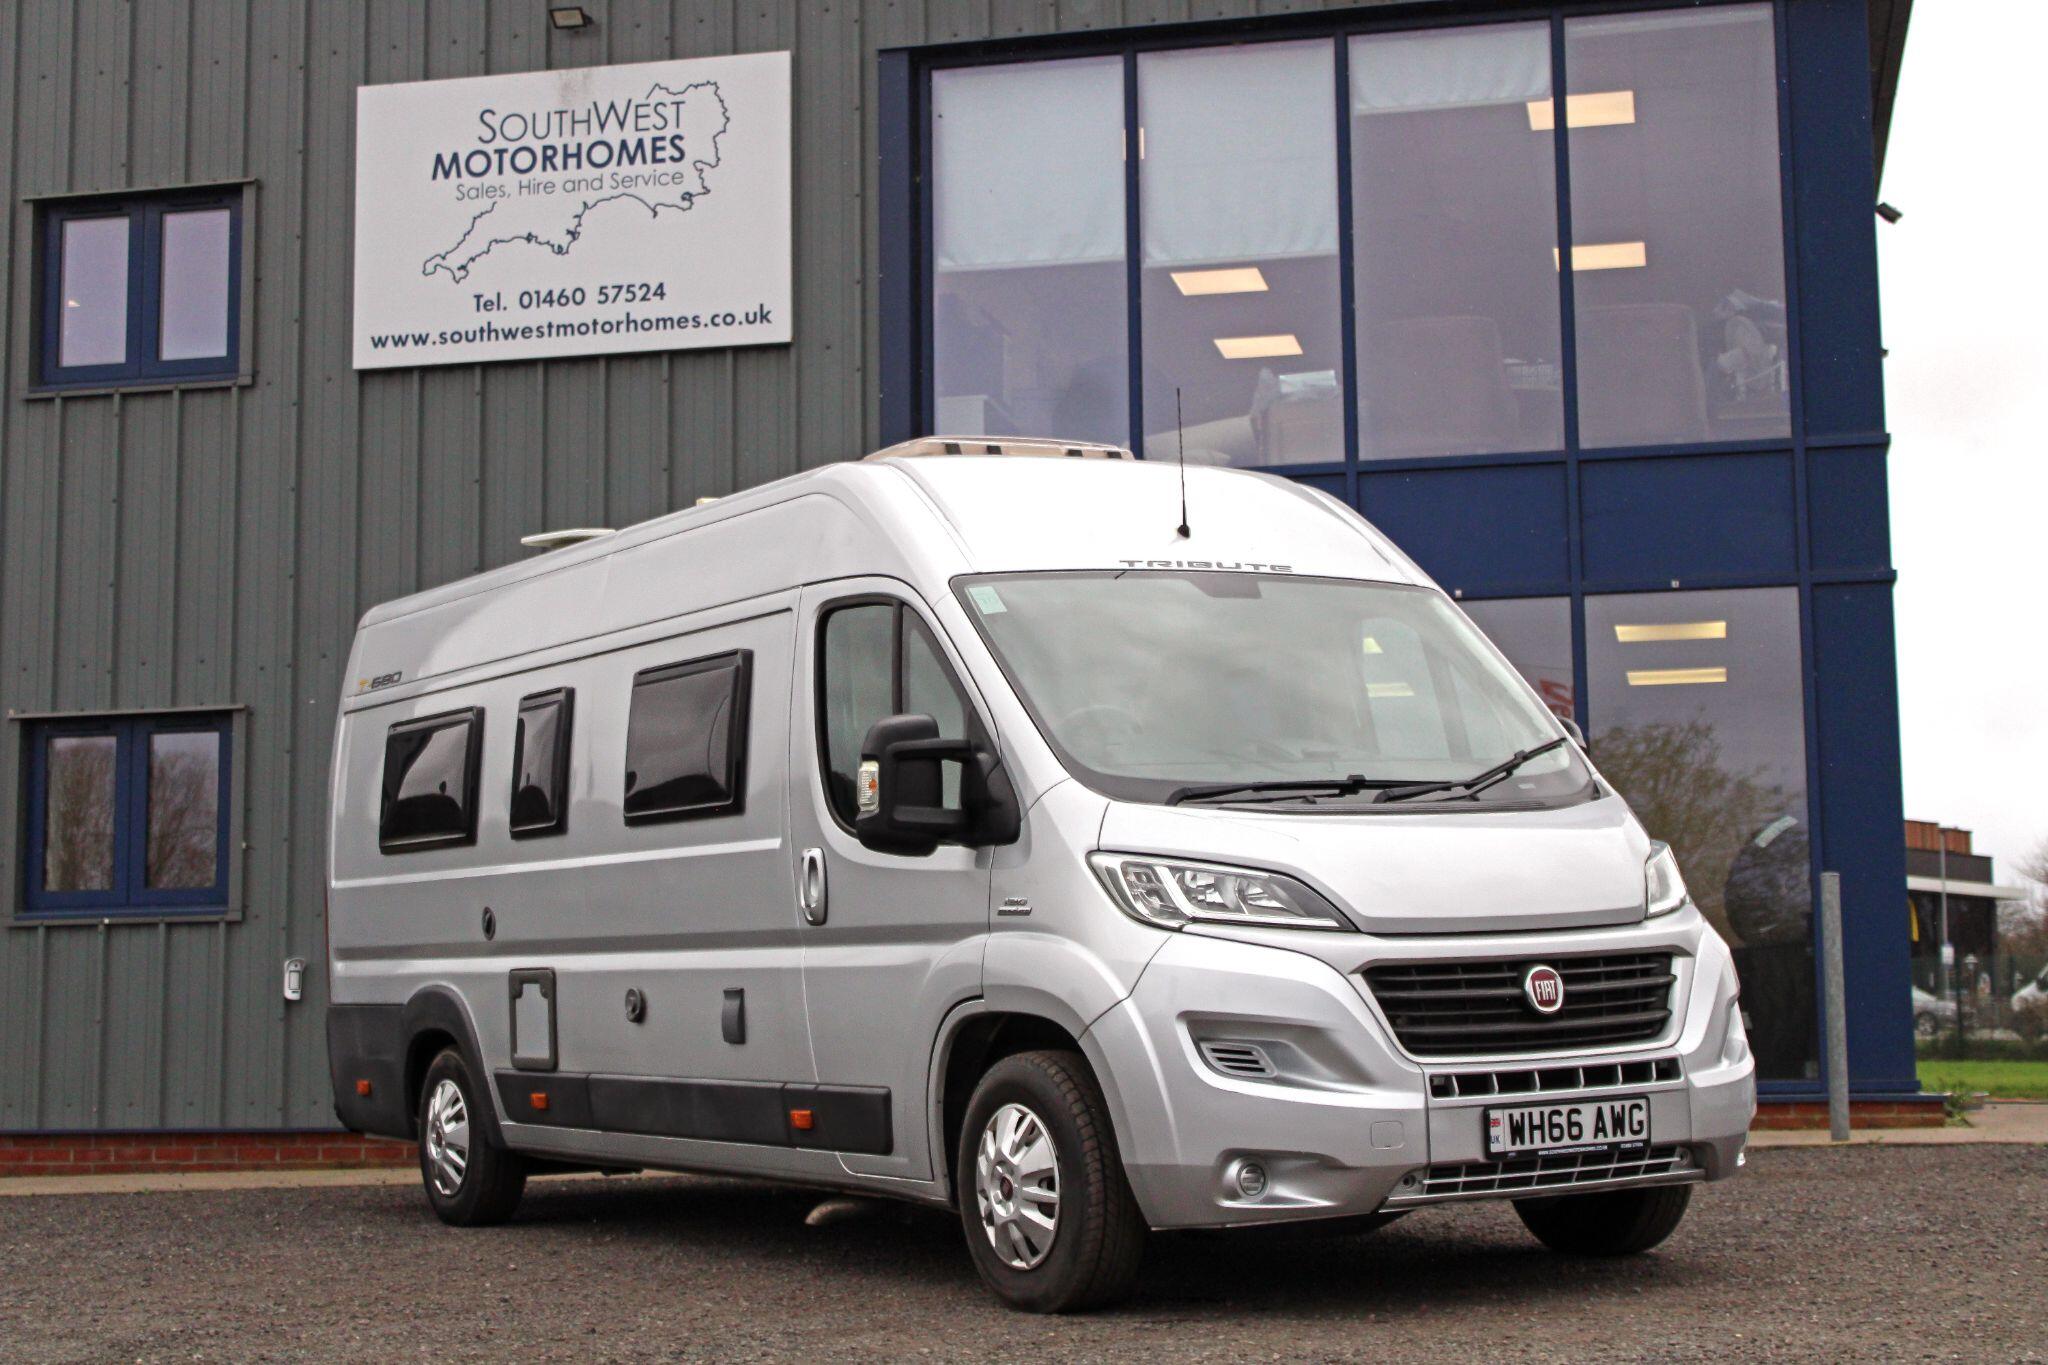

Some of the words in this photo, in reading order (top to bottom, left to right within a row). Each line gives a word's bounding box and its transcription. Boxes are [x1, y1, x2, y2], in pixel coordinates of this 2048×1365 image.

[431, 134, 686, 181] MOTORHOMES
[456, 183, 511, 202] Sales,
[518, 179, 556, 196] Hire
[563, 175, 603, 194] and
[611, 170, 684, 190] Service
[473, 293, 508, 313] Tel.
[519, 287, 585, 309] 01460
[597, 282, 666, 305] 57524
[370, 304, 772, 349] www.southwestmotorhomes.co.uk
[1119, 560, 1292, 573] TRIBUTE
[1535, 980, 1556, 1001] FIAT
[1508, 1107, 1583, 1147] WH66
[1593, 1103, 1646, 1140] AWG
